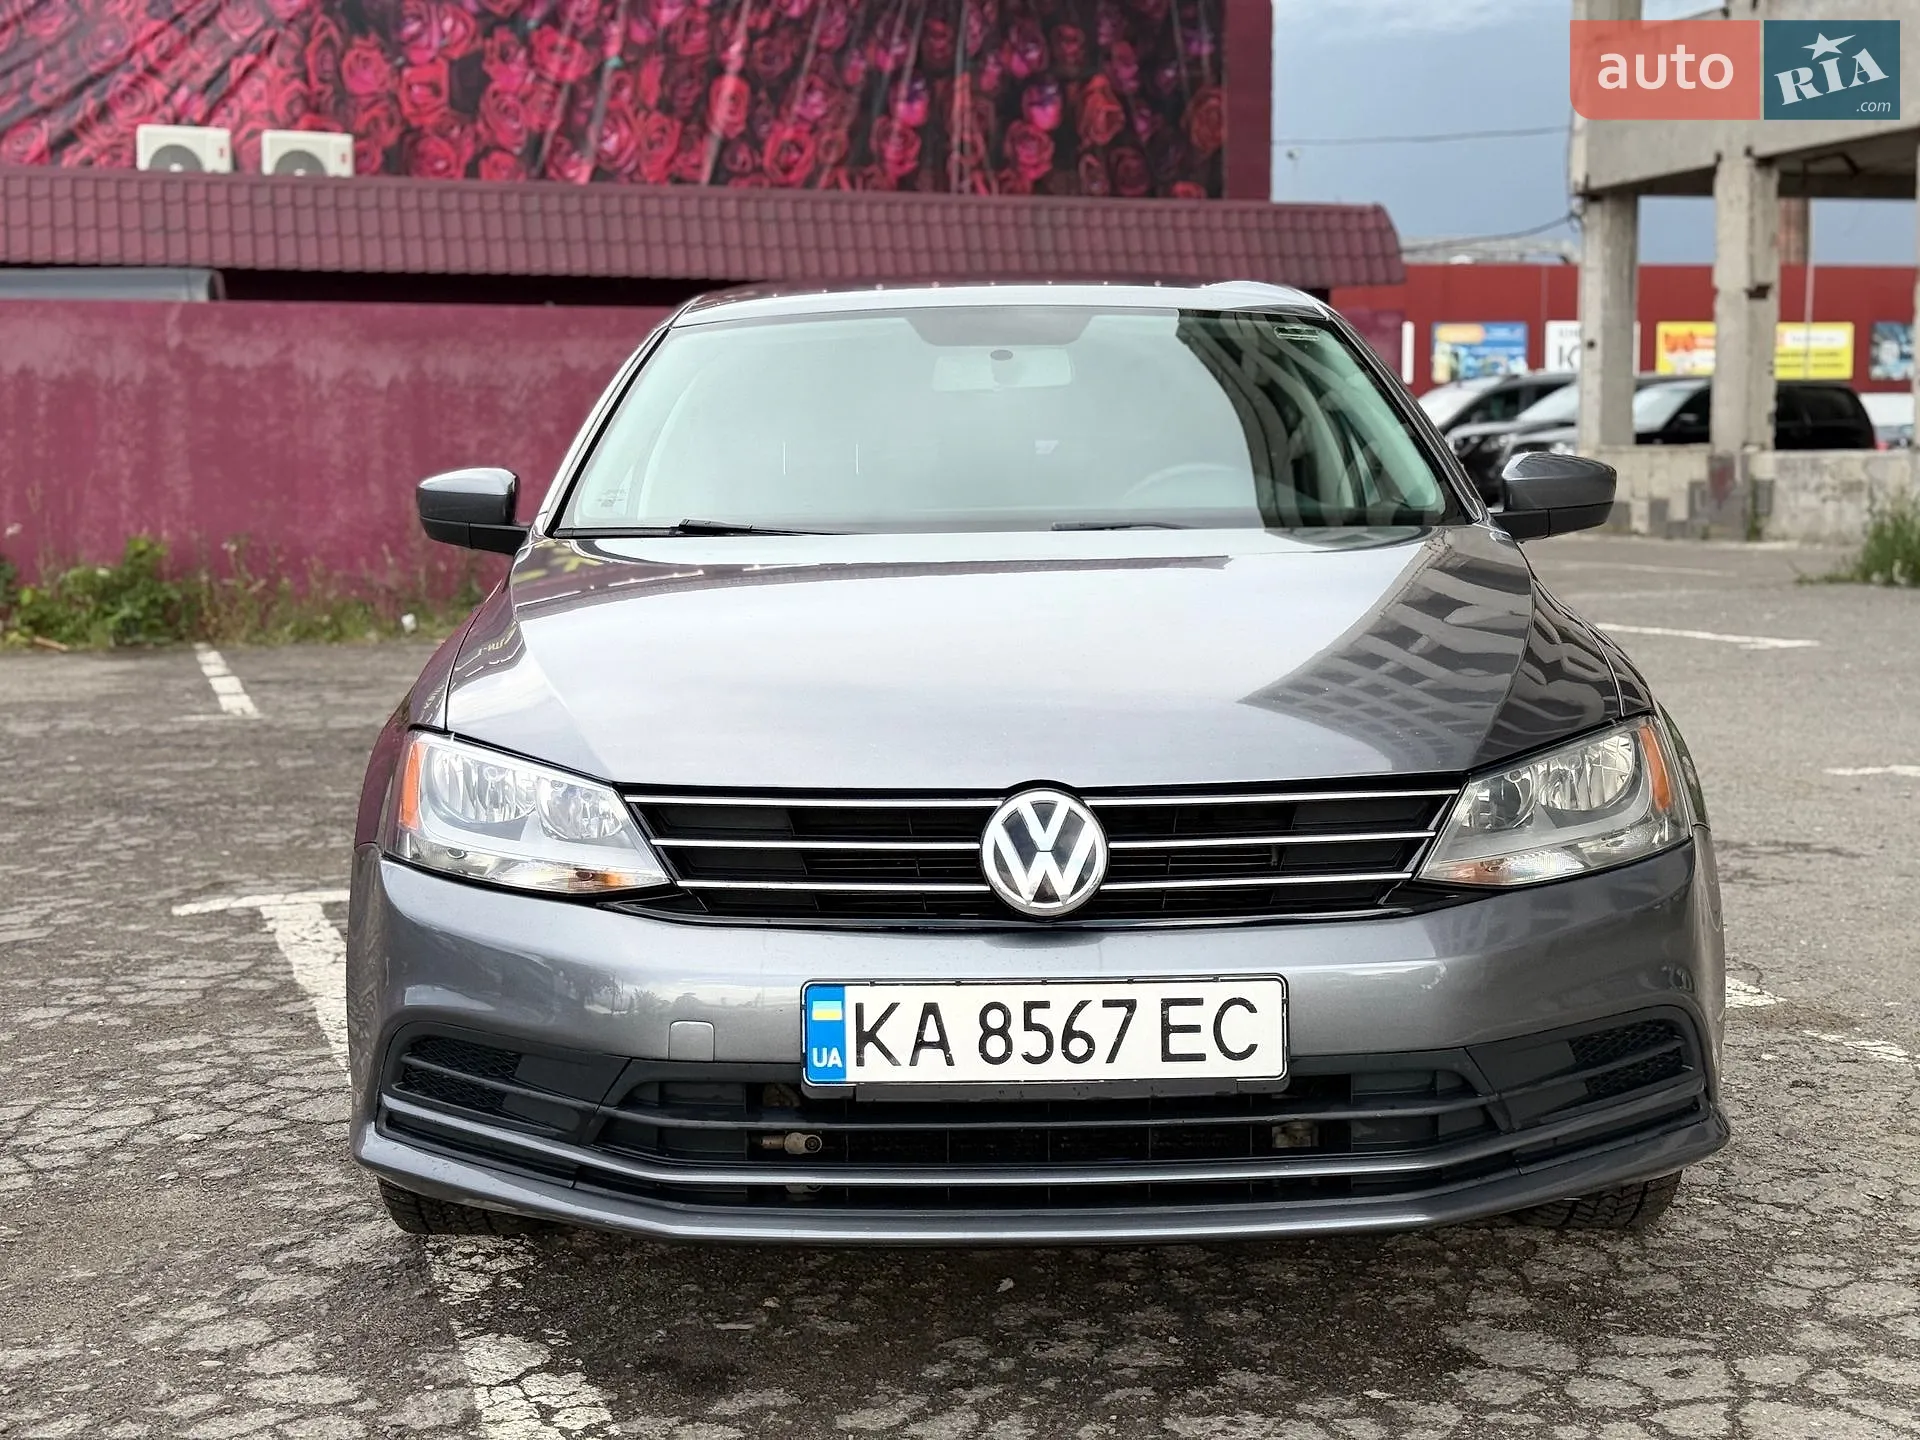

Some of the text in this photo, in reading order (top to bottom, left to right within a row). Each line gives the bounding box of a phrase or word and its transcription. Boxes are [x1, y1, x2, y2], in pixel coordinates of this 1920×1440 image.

[855, 996, 1258, 1067] KA 8567 EC
[812, 1047, 843, 1068] UA
